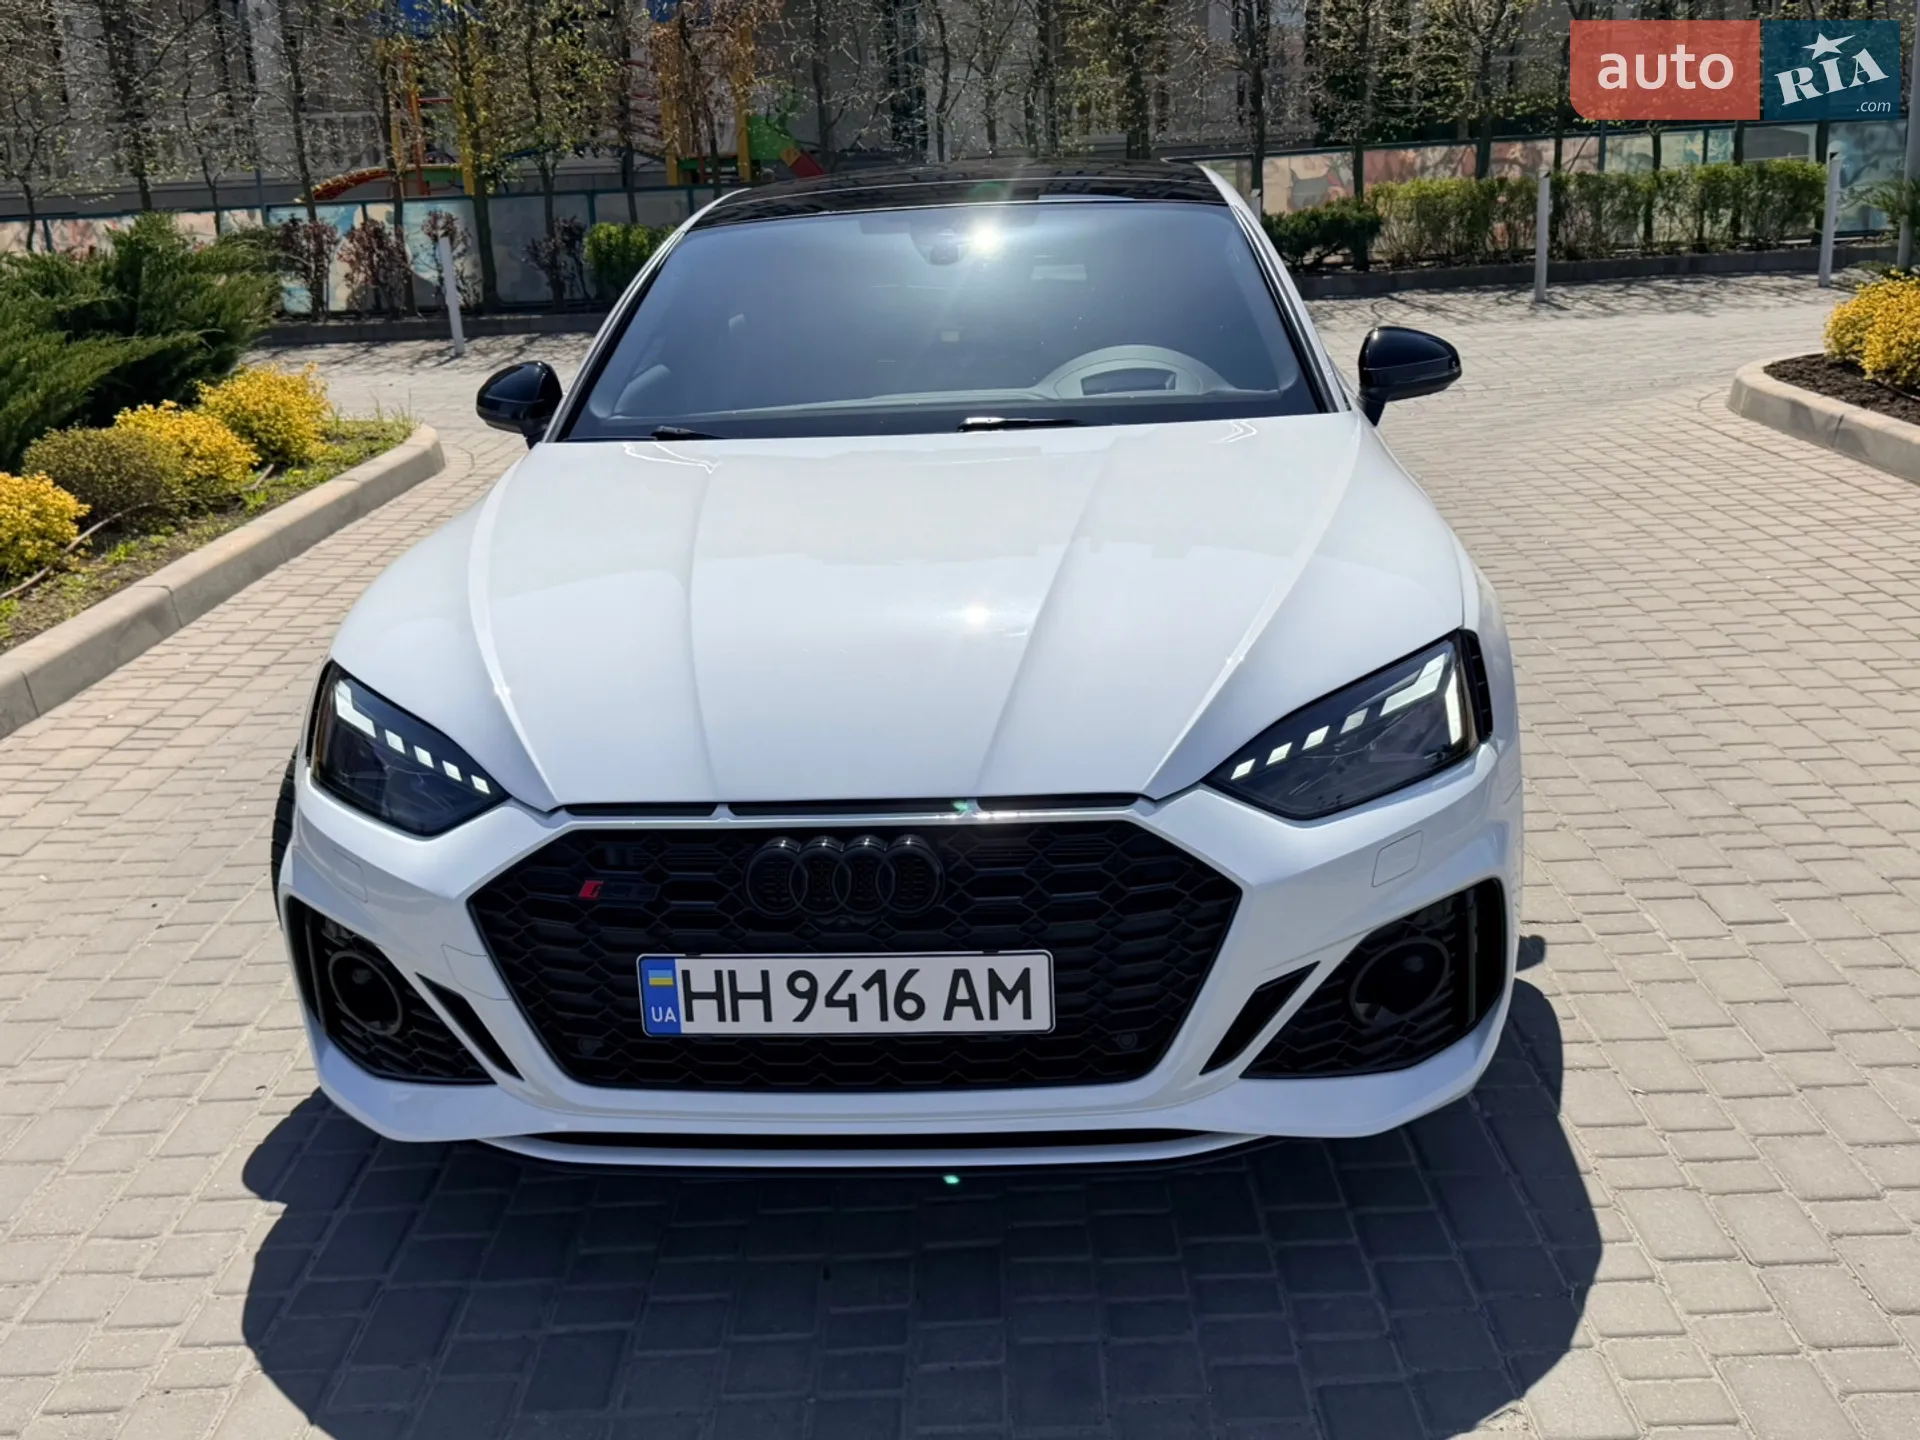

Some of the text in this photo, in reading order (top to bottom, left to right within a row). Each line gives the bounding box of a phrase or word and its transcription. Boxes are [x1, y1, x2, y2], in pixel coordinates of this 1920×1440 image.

[681, 967, 1032, 1022] HH 9416 AM
[652, 1006, 677, 1023] UA
